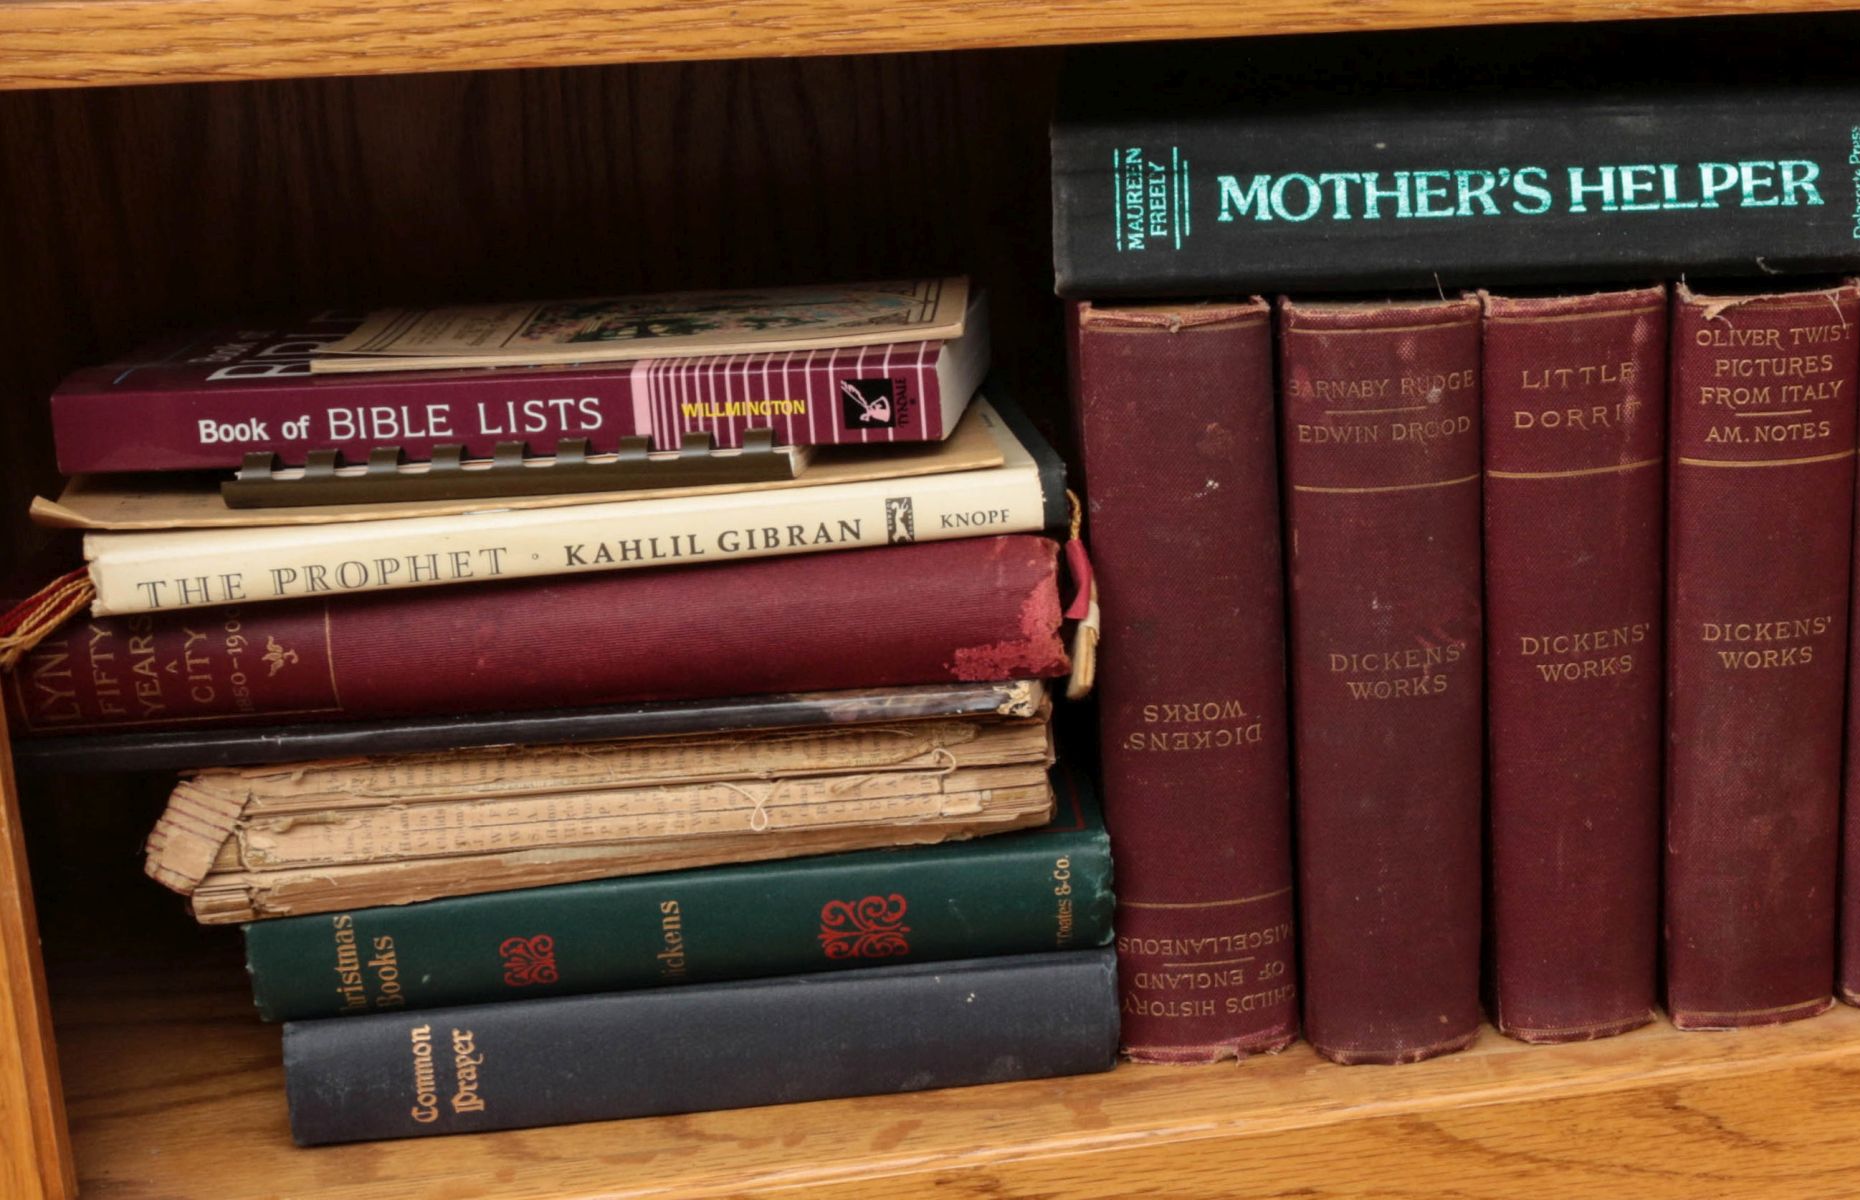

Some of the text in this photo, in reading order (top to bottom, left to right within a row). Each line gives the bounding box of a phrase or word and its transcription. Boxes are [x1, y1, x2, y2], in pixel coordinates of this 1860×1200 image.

[1126, 146, 1145, 251] MAUREEN
[1149, 161, 1167, 237] FREELY
[1217, 160, 1825, 222] MOTHER'S HELPER
[1695, 323, 1854, 351] OLIVER TWIST
[1400, 369, 1475, 396] RUDGE
[1521, 361, 1637, 390] LITTLE
[1714, 355, 1833, 380] PICTURES
[681, 398, 806, 419] WILLMINGTON
[1700, 379, 1844, 410] FROM ITALY
[199, 397, 603, 443] Book of BIBLE LISTS
[1299, 415, 1471, 445] EDWIN DROOD
[1514, 399, 1642, 431] DORRIT
[1754, 421, 1831, 443] NOTES
[136, 572, 247, 610] THE
[271, 547, 508, 597] PROPHET
[565, 532, 705, 568] KAHLIL
[717, 518, 863, 555] GIBRAN
[940, 509, 1011, 530] KNOPF
[1520, 623, 1651, 657] DICKENS'
[1702, 616, 1833, 643] DICKENS'
[88, 623, 127, 716] FIFTY
[128, 614, 167, 717] YEARS
[165, 660, 178, 674] A
[183, 626, 216, 703] CITY
[1329, 642, 1467, 674] DICKENS'
[1536, 654, 1633, 683] WORKS
[1717, 645, 1813, 671] WORKS
[1346, 674, 1449, 701] WORKS
[1142, 699, 1246, 724] WORKS
[1123, 722, 1262, 751] DICKENS'
[1117, 920, 1296, 956] MISCELLANEOUS
[367, 935, 404, 1007] Books
[1134, 960, 1286, 990] OF ENGLAND
[1120, 983, 1297, 1017] CHILD'S HISTORY
[410, 1023, 438, 1123] Common
[451, 1028, 485, 1114] Prayer
